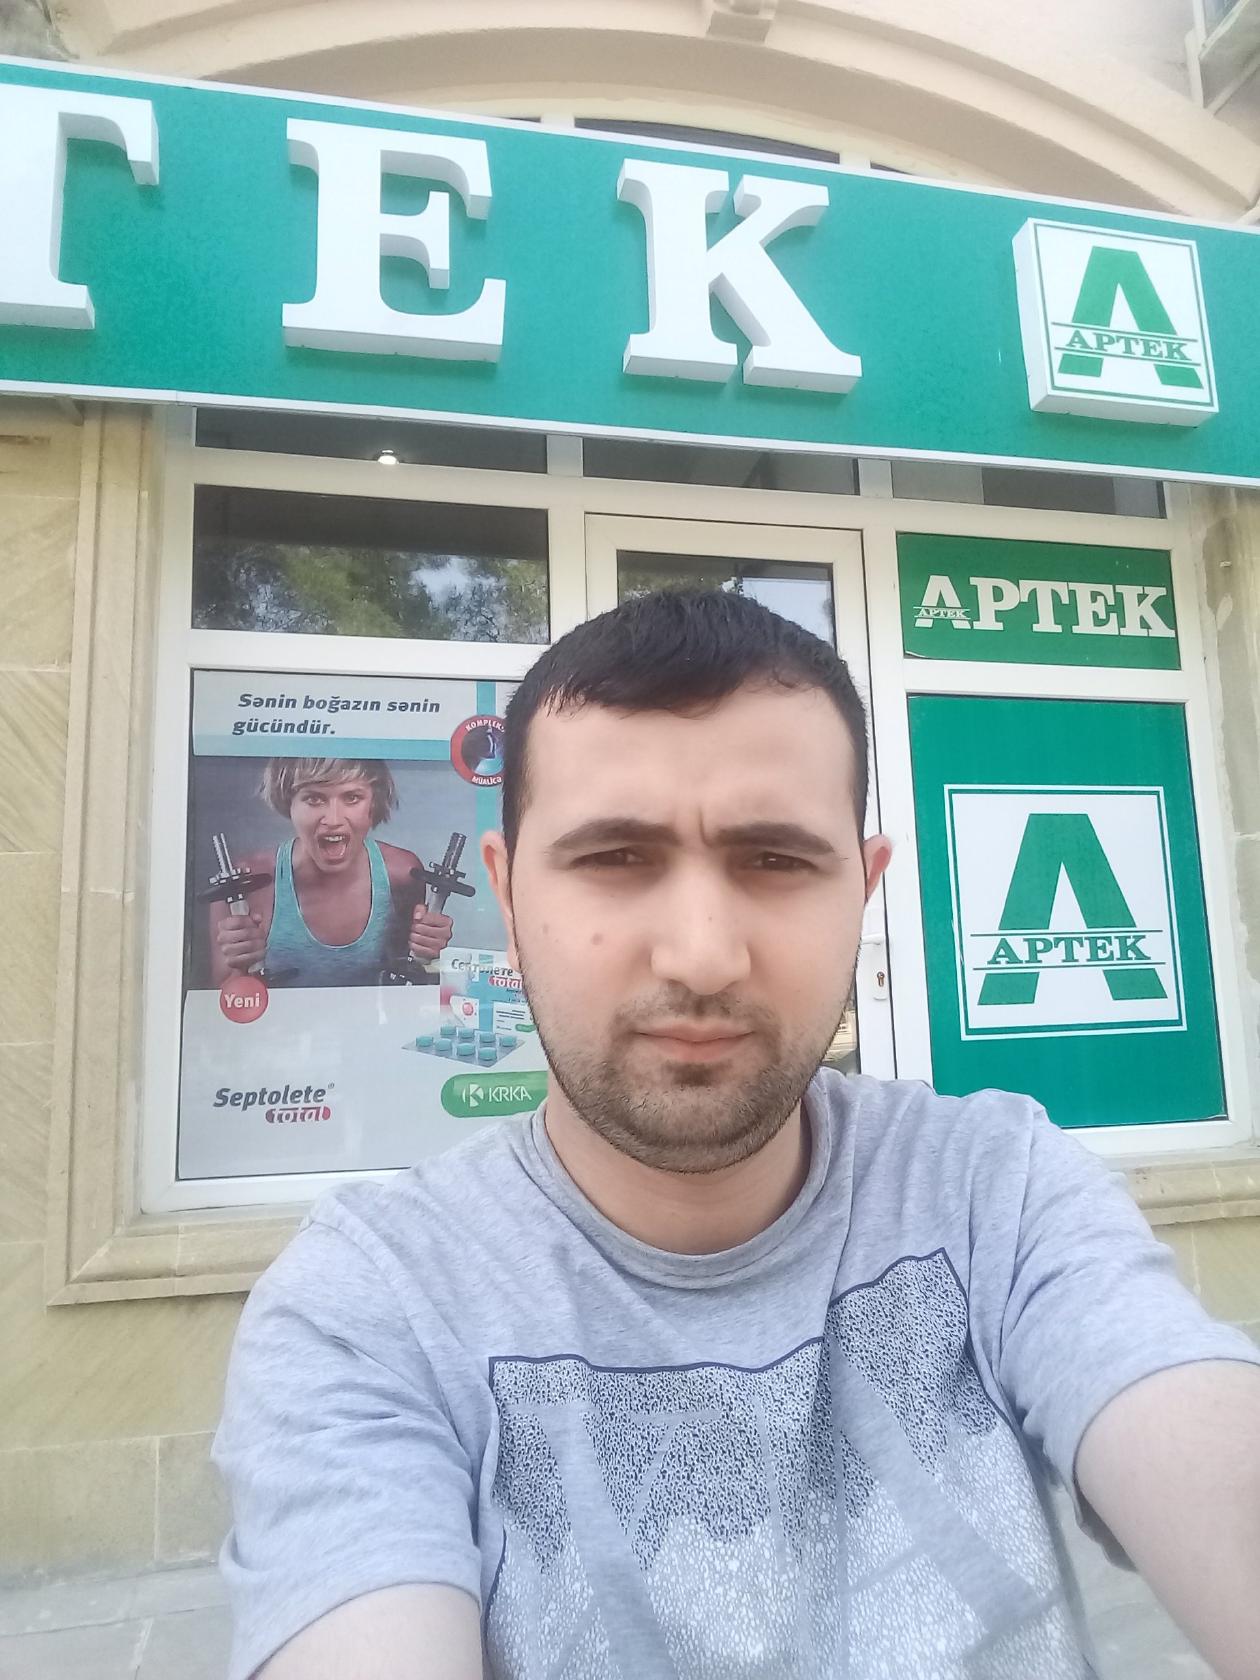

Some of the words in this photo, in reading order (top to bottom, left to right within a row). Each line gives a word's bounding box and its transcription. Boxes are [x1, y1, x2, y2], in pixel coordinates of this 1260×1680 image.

[1066, 329, 1192, 361] APTEK
[914, 574, 1176, 638] APTEK
[238, 693, 297, 709] Sənin
[302, 695, 381, 713] boğazın
[386, 698, 440, 713] sənin
[232, 718, 335, 736] gücündür.
[987, 935, 1151, 965] APTEK
[224, 992, 260, 1008] Yeni
[488, 1085, 532, 1102] KRKA
